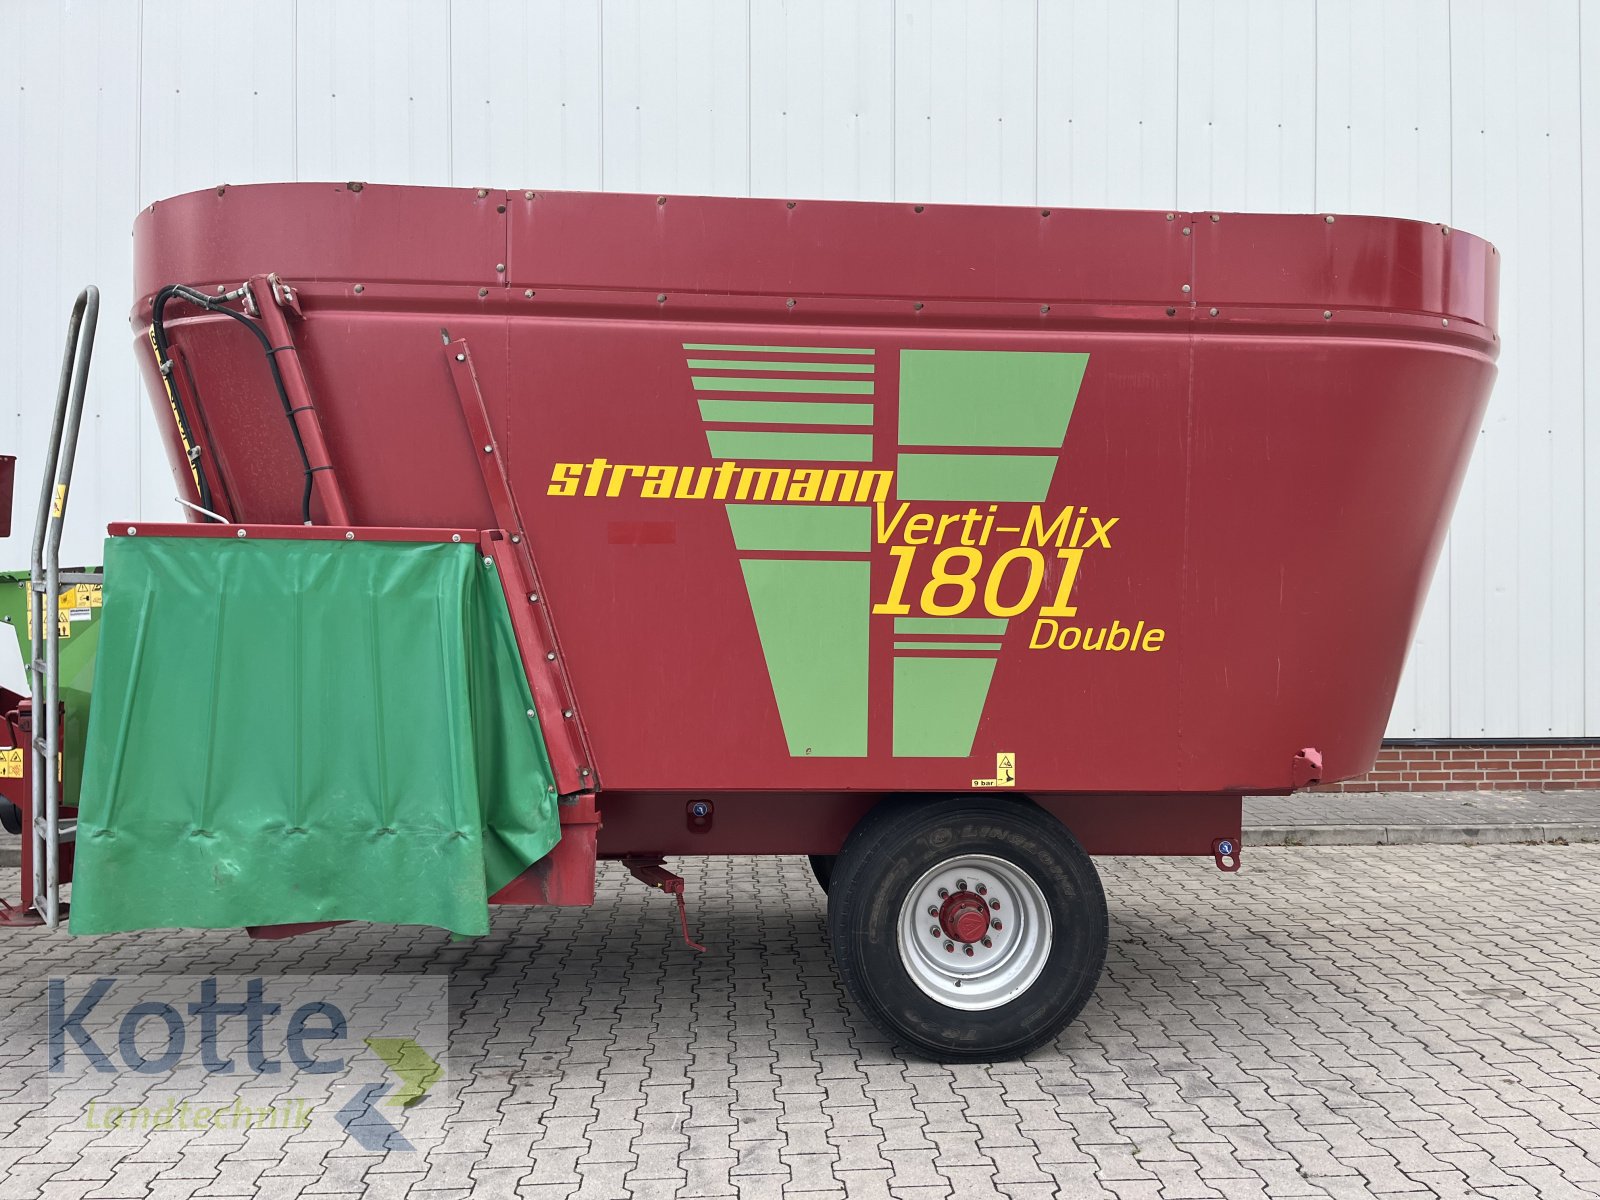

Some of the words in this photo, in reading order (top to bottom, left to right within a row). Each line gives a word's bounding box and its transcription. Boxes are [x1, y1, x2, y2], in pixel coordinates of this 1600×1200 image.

[547, 458, 894, 503] strautmann
[876, 502, 1119, 549] Verti-Mix
[872, 545, 1084, 618] 1801
[1029, 618, 1166, 652] Double
